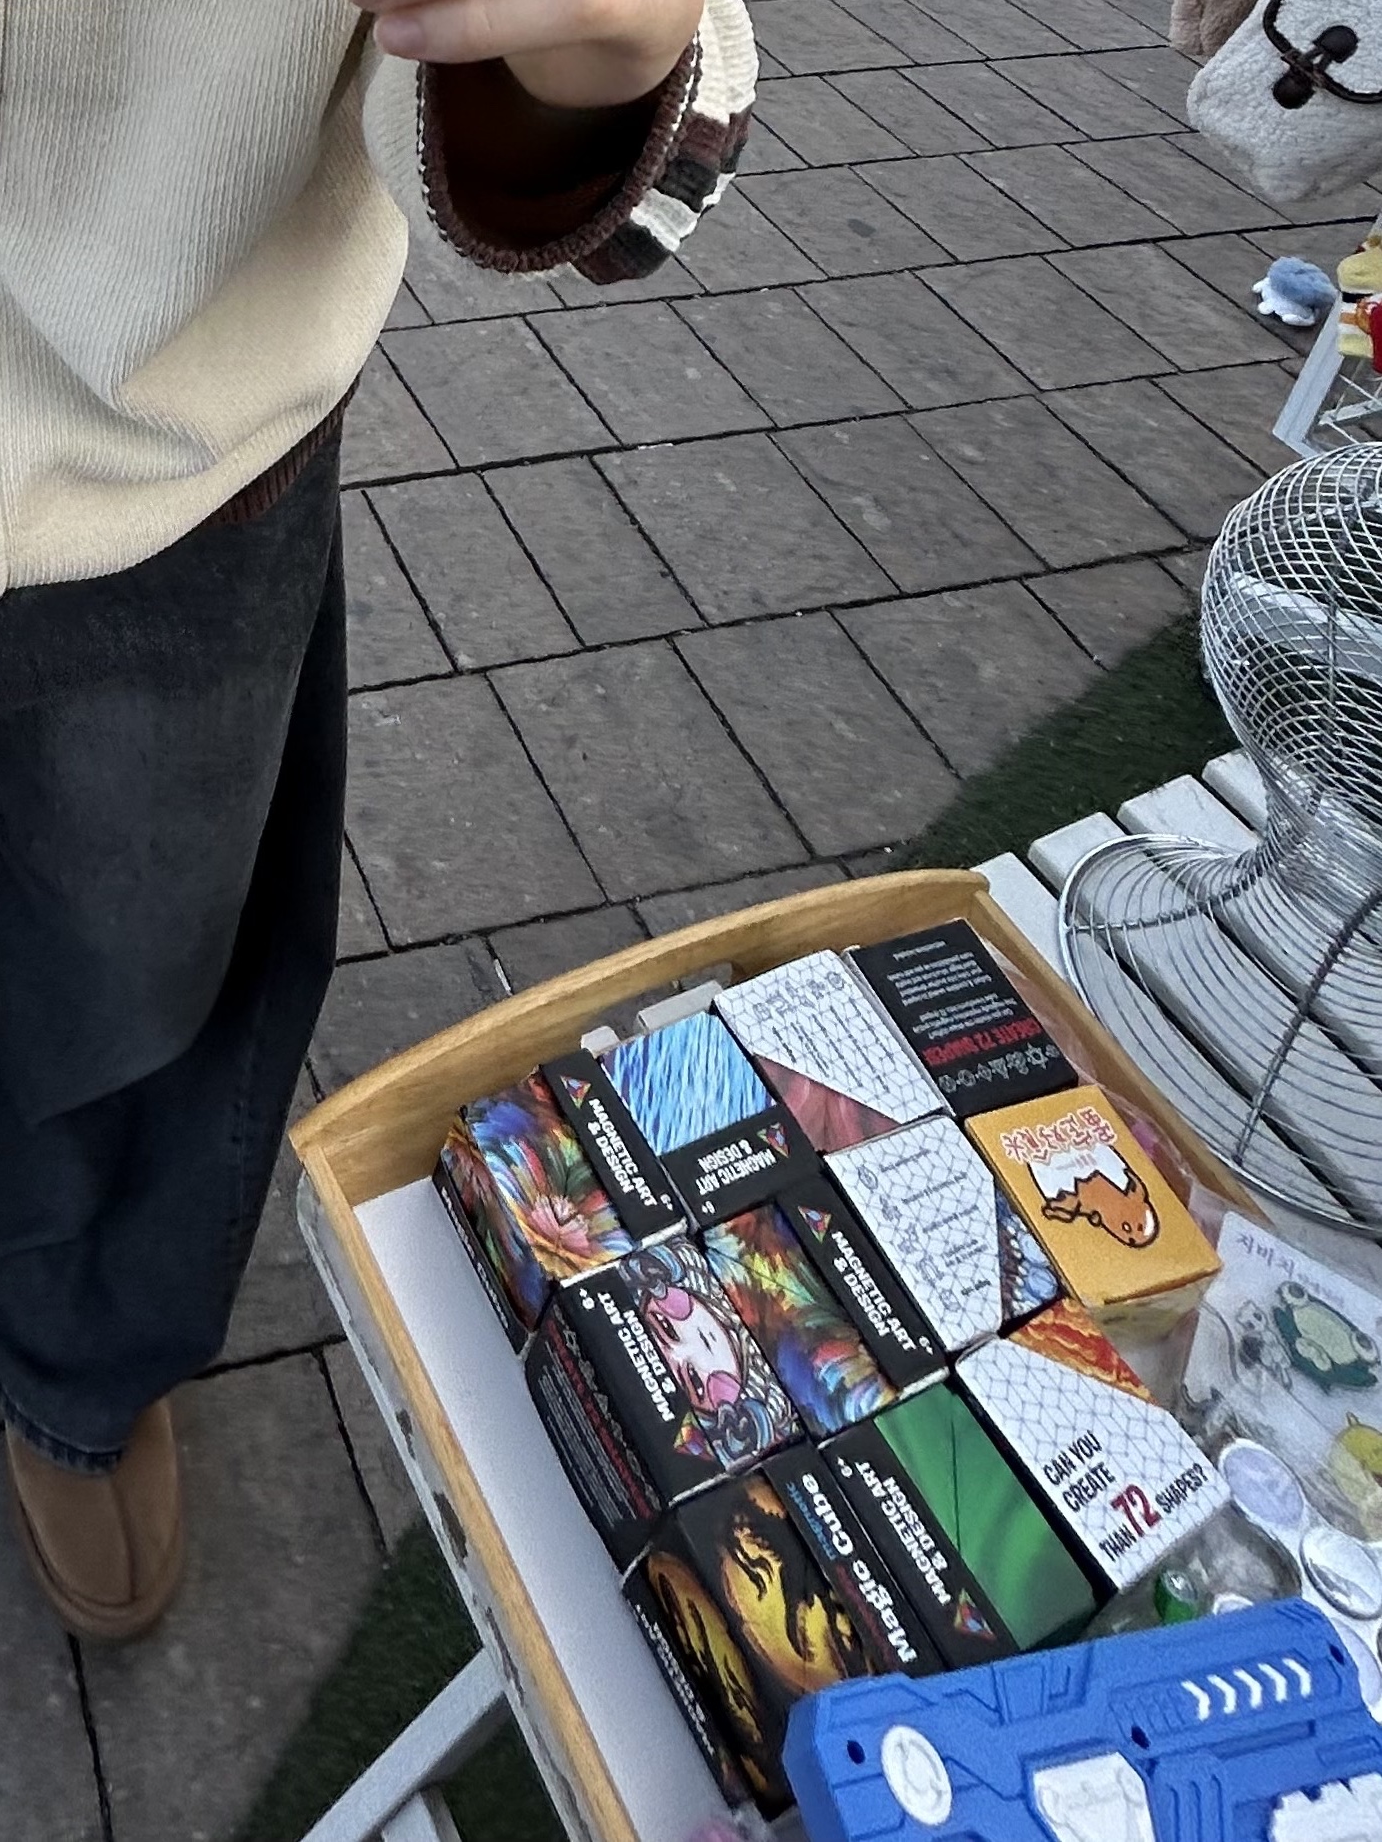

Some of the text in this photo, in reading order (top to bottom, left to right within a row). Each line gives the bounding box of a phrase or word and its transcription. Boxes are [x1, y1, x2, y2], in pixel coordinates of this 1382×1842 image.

[588, 1098, 658, 1206] MAGNETIC ART
[595, 1135, 635, 1194] DESIGN
[695, 1148, 777, 1196] MAGNETIC ART
[697, 1143, 744, 1174] DESIGN
[597, 1292, 624, 1325] ART
[831, 1231, 917, 1351] MAGNETIC ART
[843, 1273, 890, 1337] DESIGN
[617, 1327, 675, 1422] MAGNETIC
[622, 1309, 667, 1376] DESIGN
[1043, 1429, 1103, 1486] CAN YOU
[1062, 1461, 1116, 1513] CREATE
[801, 1473, 854, 1556] Cube
[854, 1461, 952, 1606] MAGNETIC ART
[882, 1476, 936, 1551] DESIGN
[1098, 1462, 1208, 1562] THAN 72 SHAPES?
[852, 1559, 918, 1664] Magic
